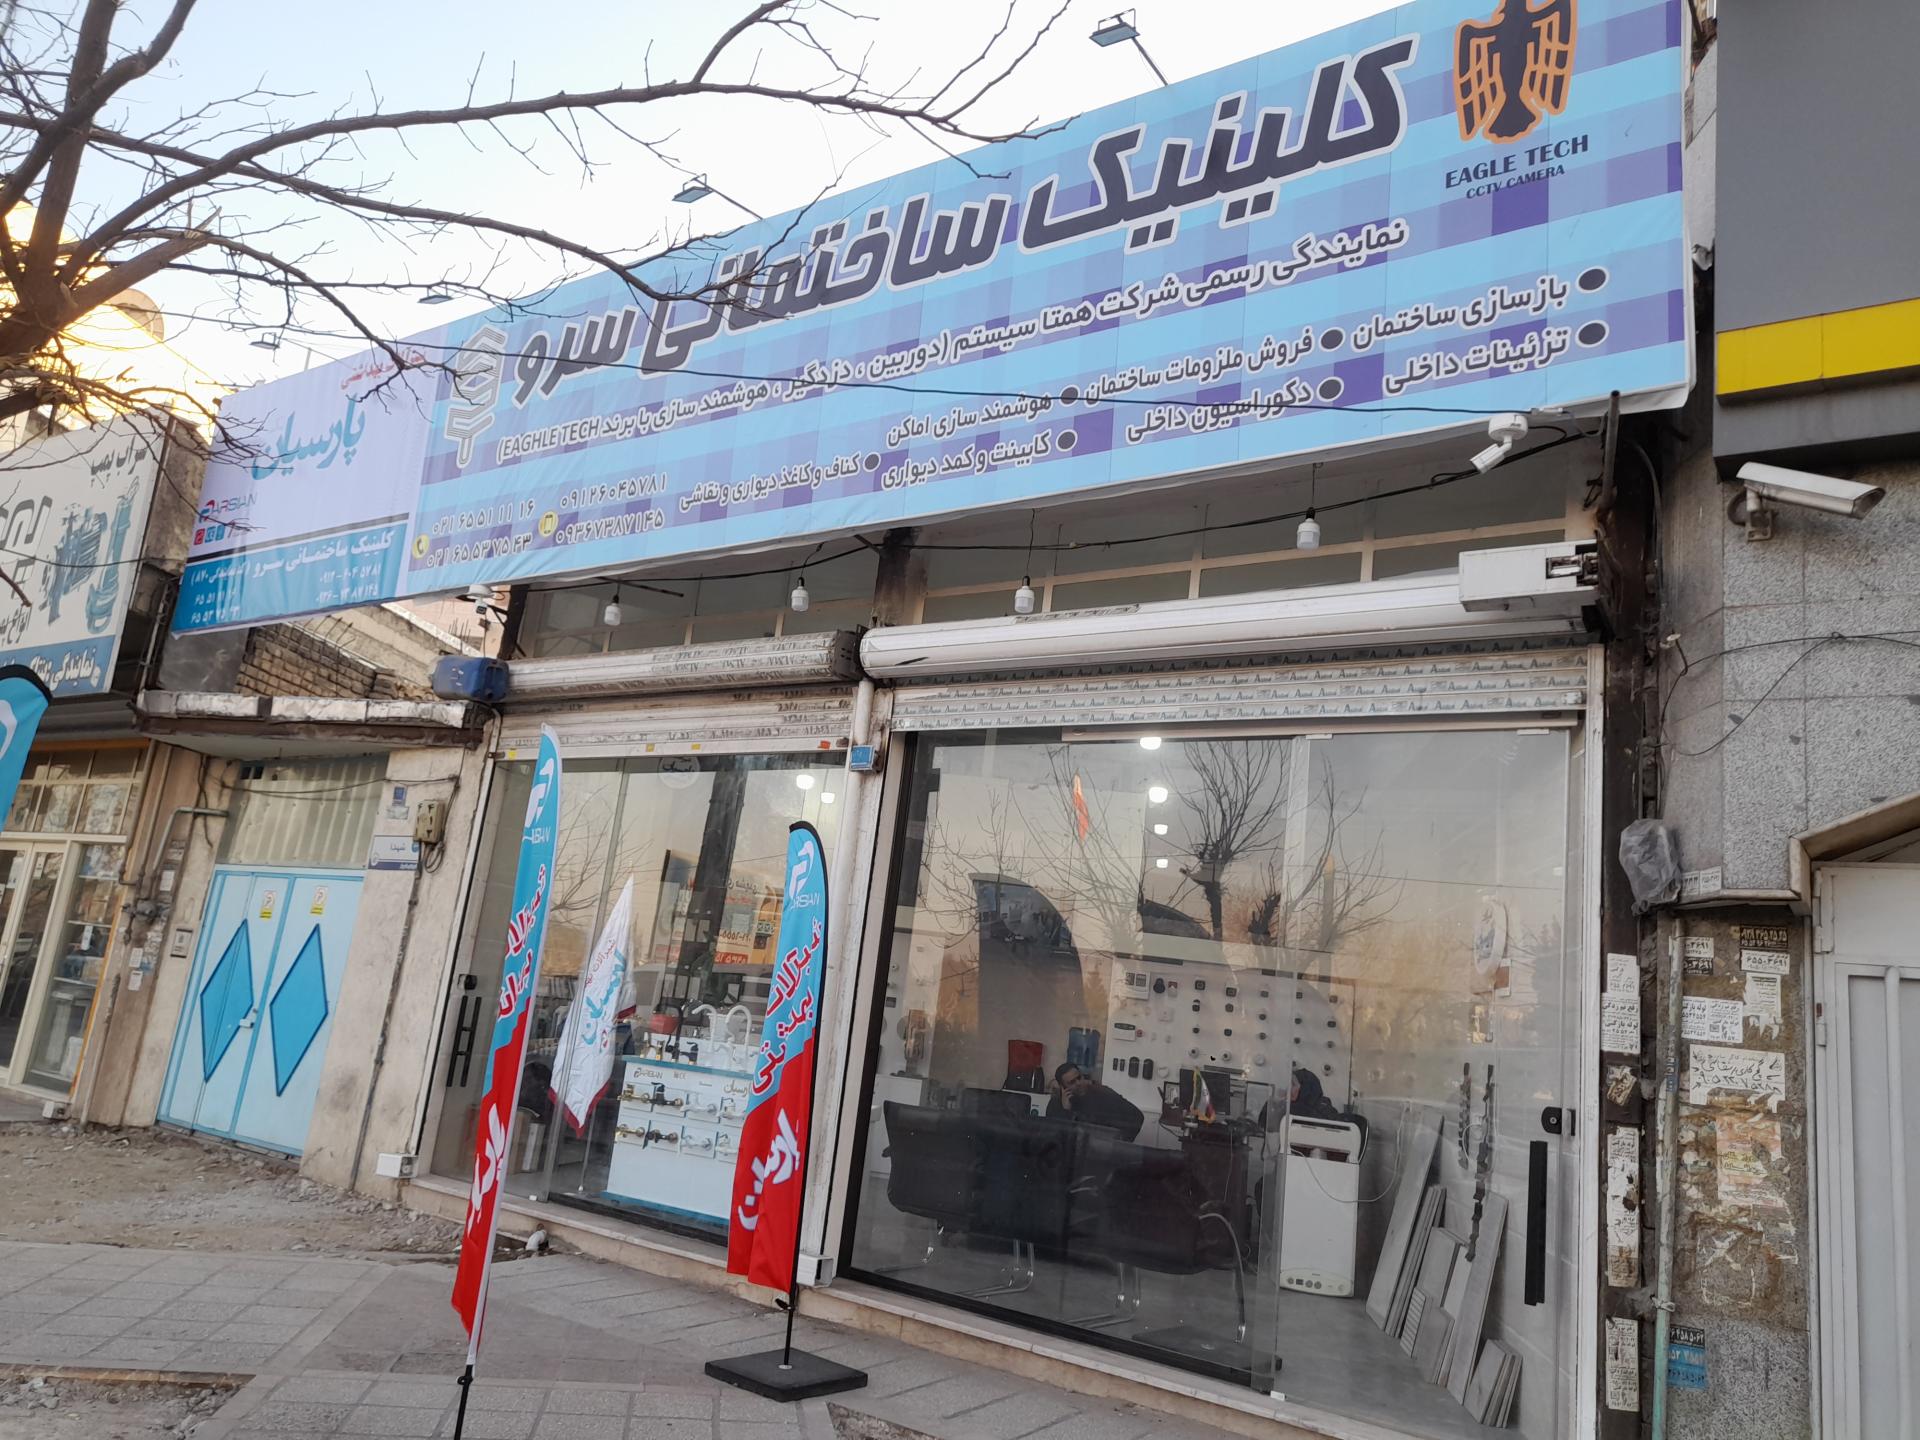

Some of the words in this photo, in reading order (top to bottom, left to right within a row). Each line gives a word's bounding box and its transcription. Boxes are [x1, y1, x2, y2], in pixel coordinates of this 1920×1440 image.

[1023, 38, 1416, 250] کلینیک
[1444, 154, 1516, 189] EAGLE
[1524, 134, 1590, 167] TECH
[1465, 181, 1506, 200] CCTV
[1506, 164, 1565, 191] CAMERA
[1272, 217, 1407, 282] نمایندگی
[641, 193, 1009, 375] ساختمانی
[1099, 273, 1180, 313] شرکت
[1186, 264, 1264, 304] رسمی
[1461, 277, 1568, 326] بازسازی
[1042, 302, 1092, 332] همتا
[1352, 304, 1456, 350] ساختمان
[514, 306, 637, 405] سرو
[953, 319, 1036, 360] سیستم
[1247, 329, 1313, 373] فروش
[1464, 328, 1567, 371] تزئینات
[1165, 346, 1243, 382] ملزومات
[1385, 350, 1460, 394] داخلی
[700, 380, 769, 412] هوشمند
[1084, 366, 1162, 405] ساختمان
[638, 408, 651, 431] با
[653, 400, 696, 428] سازی
[981, 394, 1053, 425] هوشمند
[1191, 379, 1312, 429] دکوراسیون
[251, 392, 366, 481] پارسیان
[561, 418, 601, 443] TECH
[602, 414, 638, 438] برند
[887, 416, 931, 447] اماکن
[932, 408, 978, 438] سازی
[1127, 402, 1187, 442] داخلی
[942, 446, 975, 470] کمد
[976, 451, 987, 472] و
[989, 430, 1051, 465] کابینت
[780, 464, 812, 488] کاغذ
[813, 466, 822, 488] و
[824, 453, 861, 479] کناف
[882, 457, 938, 488] دیواری
[680, 483, 722, 511] نقاشی
[720, 486, 729, 504] و
[732, 474, 777, 502] دیواری
